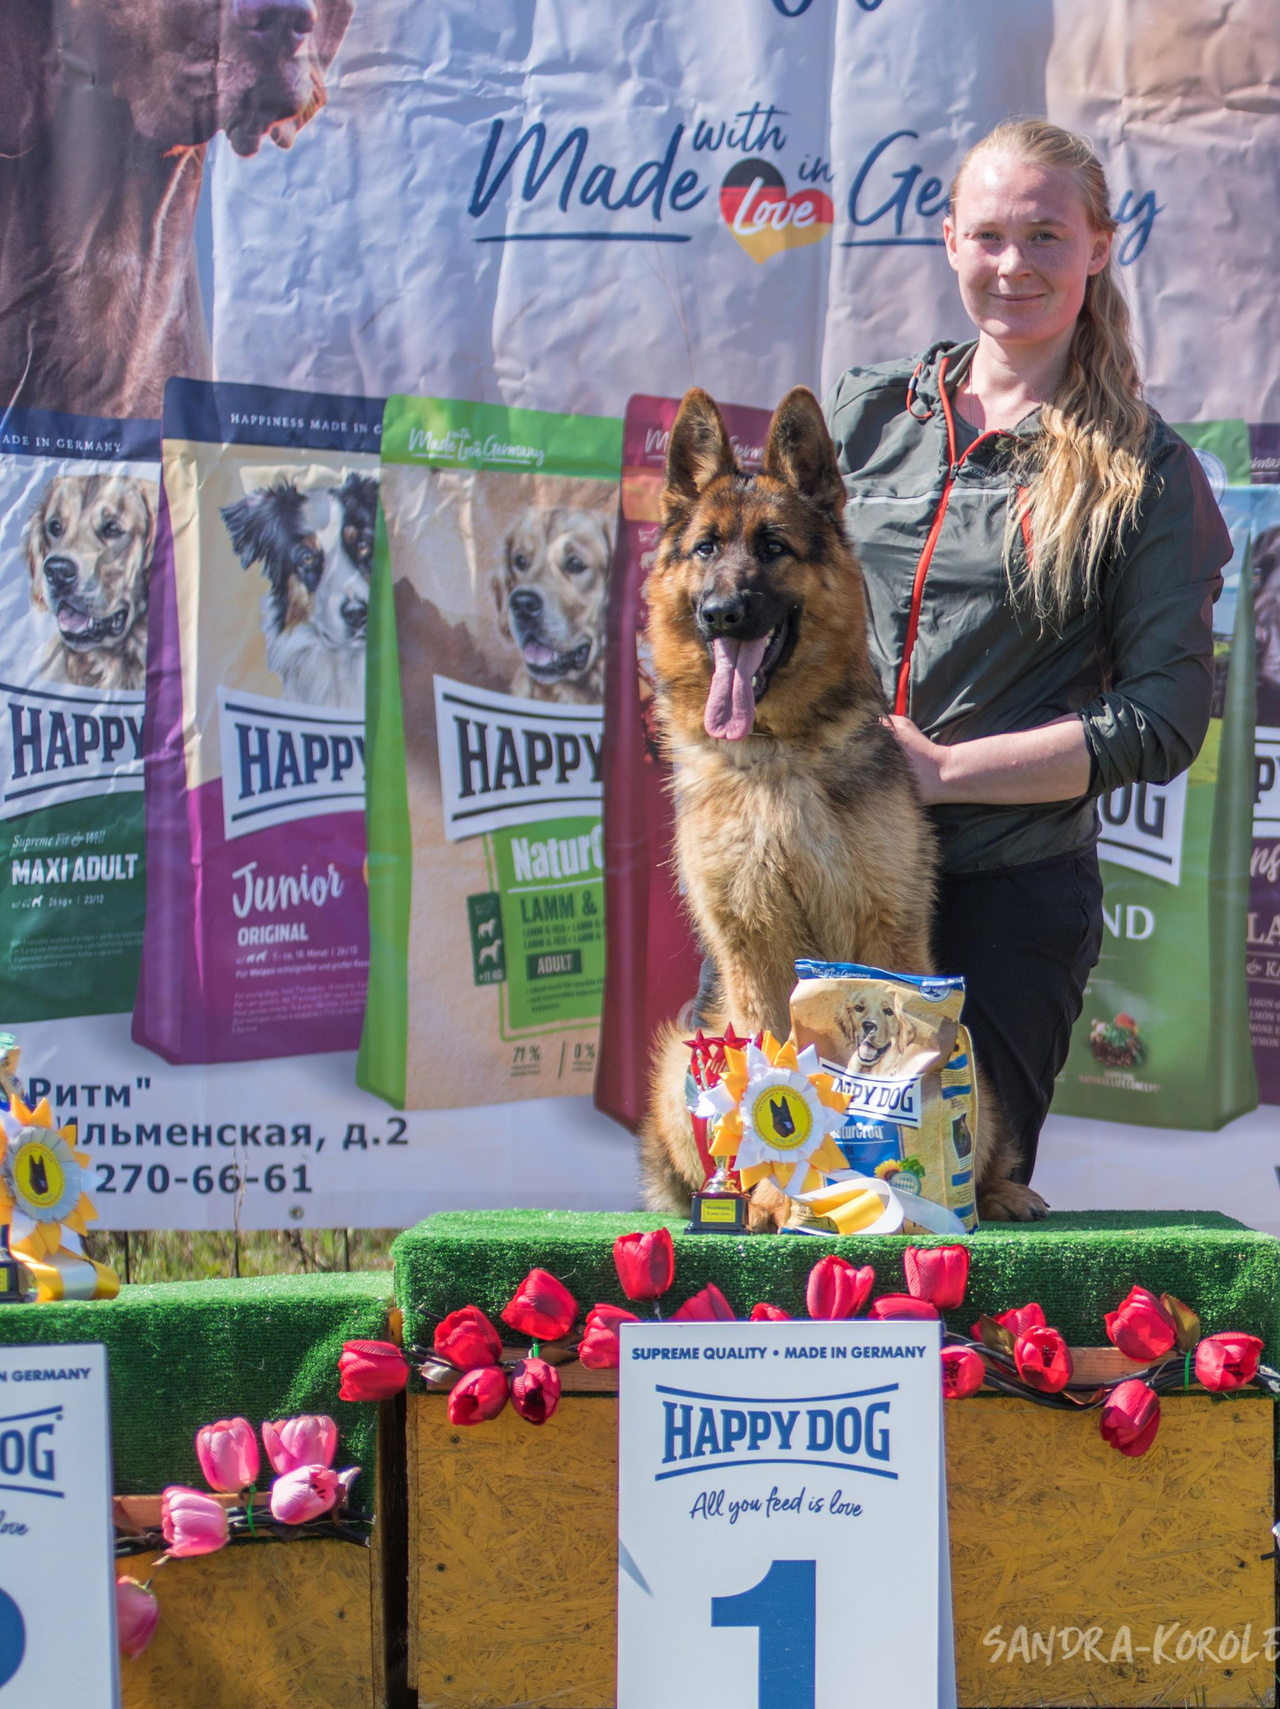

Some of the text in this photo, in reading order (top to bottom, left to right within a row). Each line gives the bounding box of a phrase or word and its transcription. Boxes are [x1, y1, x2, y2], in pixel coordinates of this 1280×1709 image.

[692, 101, 791, 151] with
[467, 119, 708, 222] Made
[798, 154, 834, 182] in
[732, 176, 818, 236] Love
[230, 413, 304, 429] HAPPINESS
[310, 419, 348, 432] MADE
[354, 423, 368, 433] IN
[2, 434, 122, 452] ADE IN GERMANY
[408, 428, 455, 452] Made
[483, 434, 545, 467] Germany
[8, 702, 145, 780] HAPPY
[453, 715, 604, 798] HAPPY
[1100, 782, 1167, 840] OG
[12, 834, 52, 852] Supreme
[55, 833, 69, 847] Fit
[511, 824, 604, 882] NaturC
[12, 853, 138, 886] MAXI ADULT
[231, 861, 344, 919] Junior
[520, 890, 598, 924] LAMM &
[237, 922, 309, 947] ORIGINAL
[537, 954, 573, 975] ADULT
[1249, 997, 1273, 1009] LMON
[1249, 1009, 1274, 1022] LMÓN
[29, 1077, 152, 1108] Ритм"
[835, 1077, 878, 1105] APPY
[876, 1083, 914, 1113] DOG
[343, 1118, 409, 1151] д.2
[95, 1163, 313, 1194] 270-66-61
[631, 1345, 927, 1360] SUPREME QUALITY MADE IN GERMANY
[12, 1367, 91, 1382] GERMANY
[661, 1401, 890, 1464] HAPPY DOG
[0, 1423, 55, 1481] OG
[689, 1486, 863, 1525] All you feed is love
[711, 1559, 817, 1709] 1
